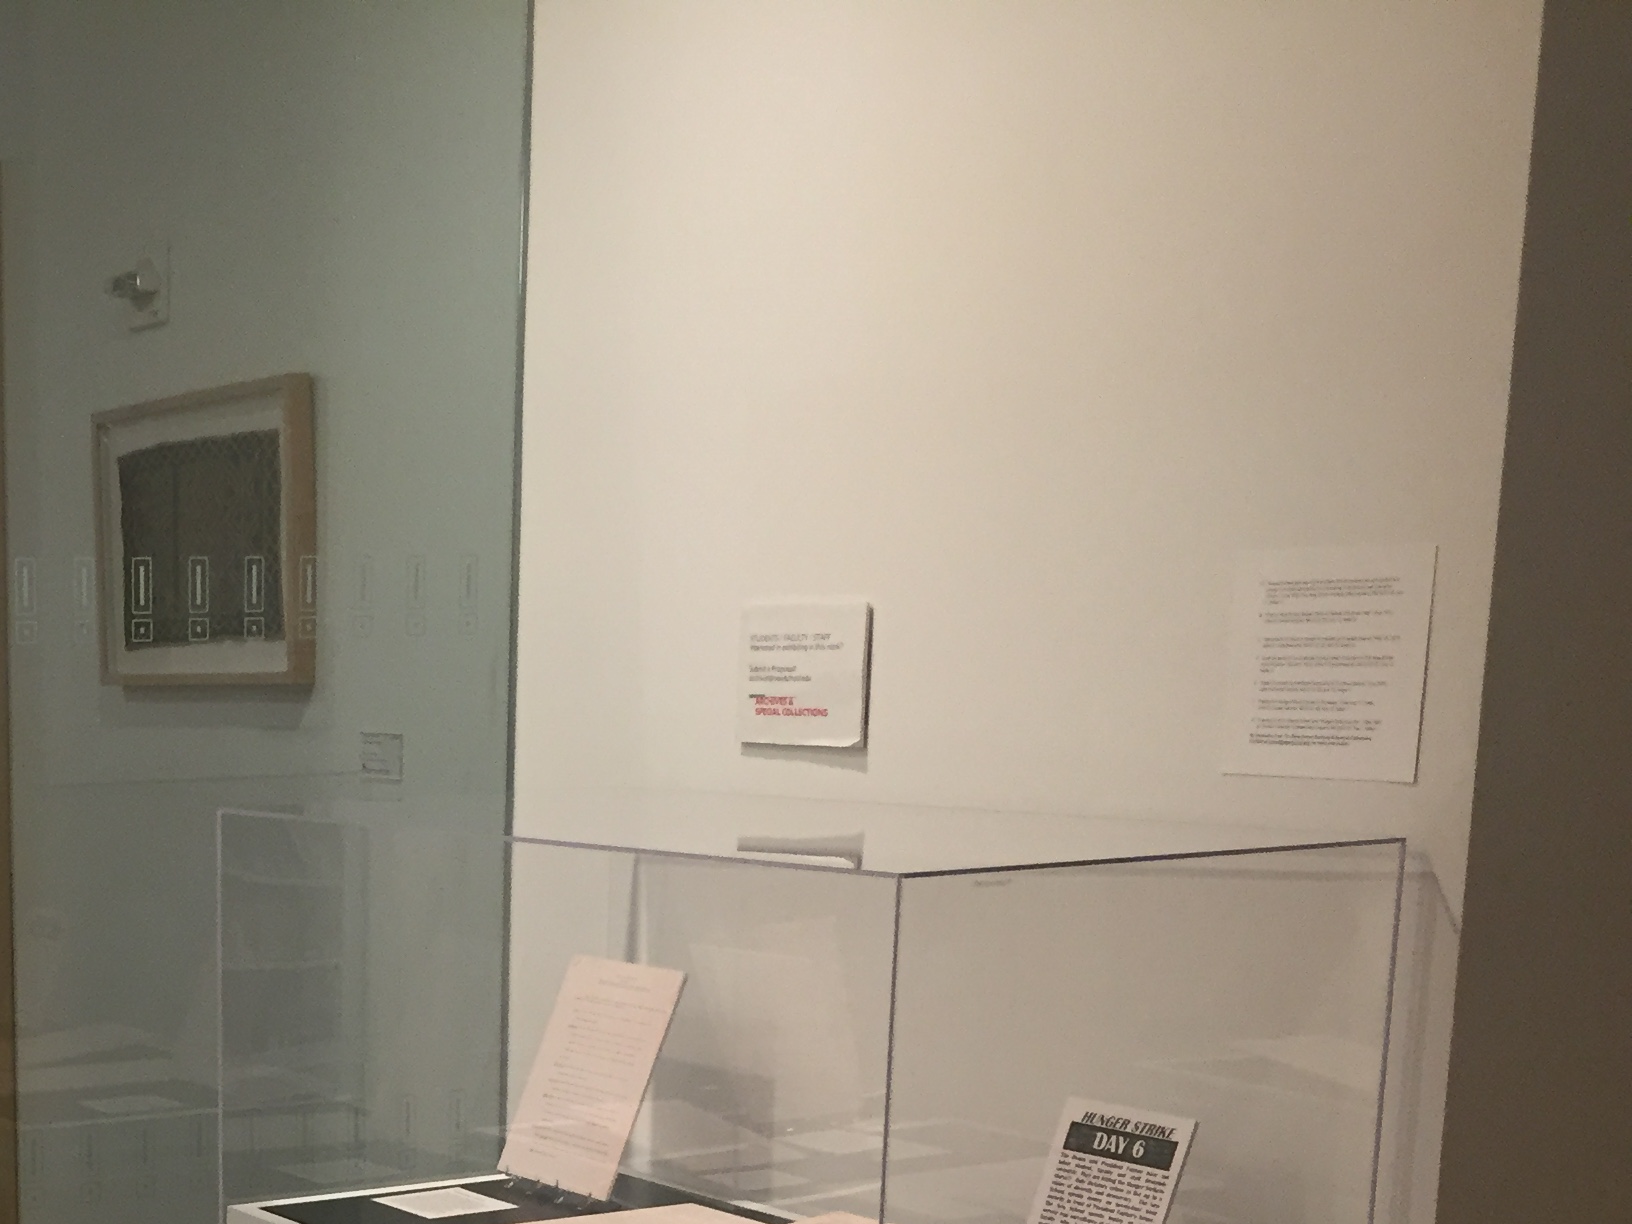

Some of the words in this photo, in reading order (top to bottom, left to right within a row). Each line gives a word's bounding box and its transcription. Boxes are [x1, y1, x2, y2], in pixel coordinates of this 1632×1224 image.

[1081, 1112, 1131, 1131] HUNGER
[1131, 1121, 1176, 1139] STRIKE
[1093, 1132, 1128, 1154] DAY
[1132, 1140, 1145, 1158] 6
